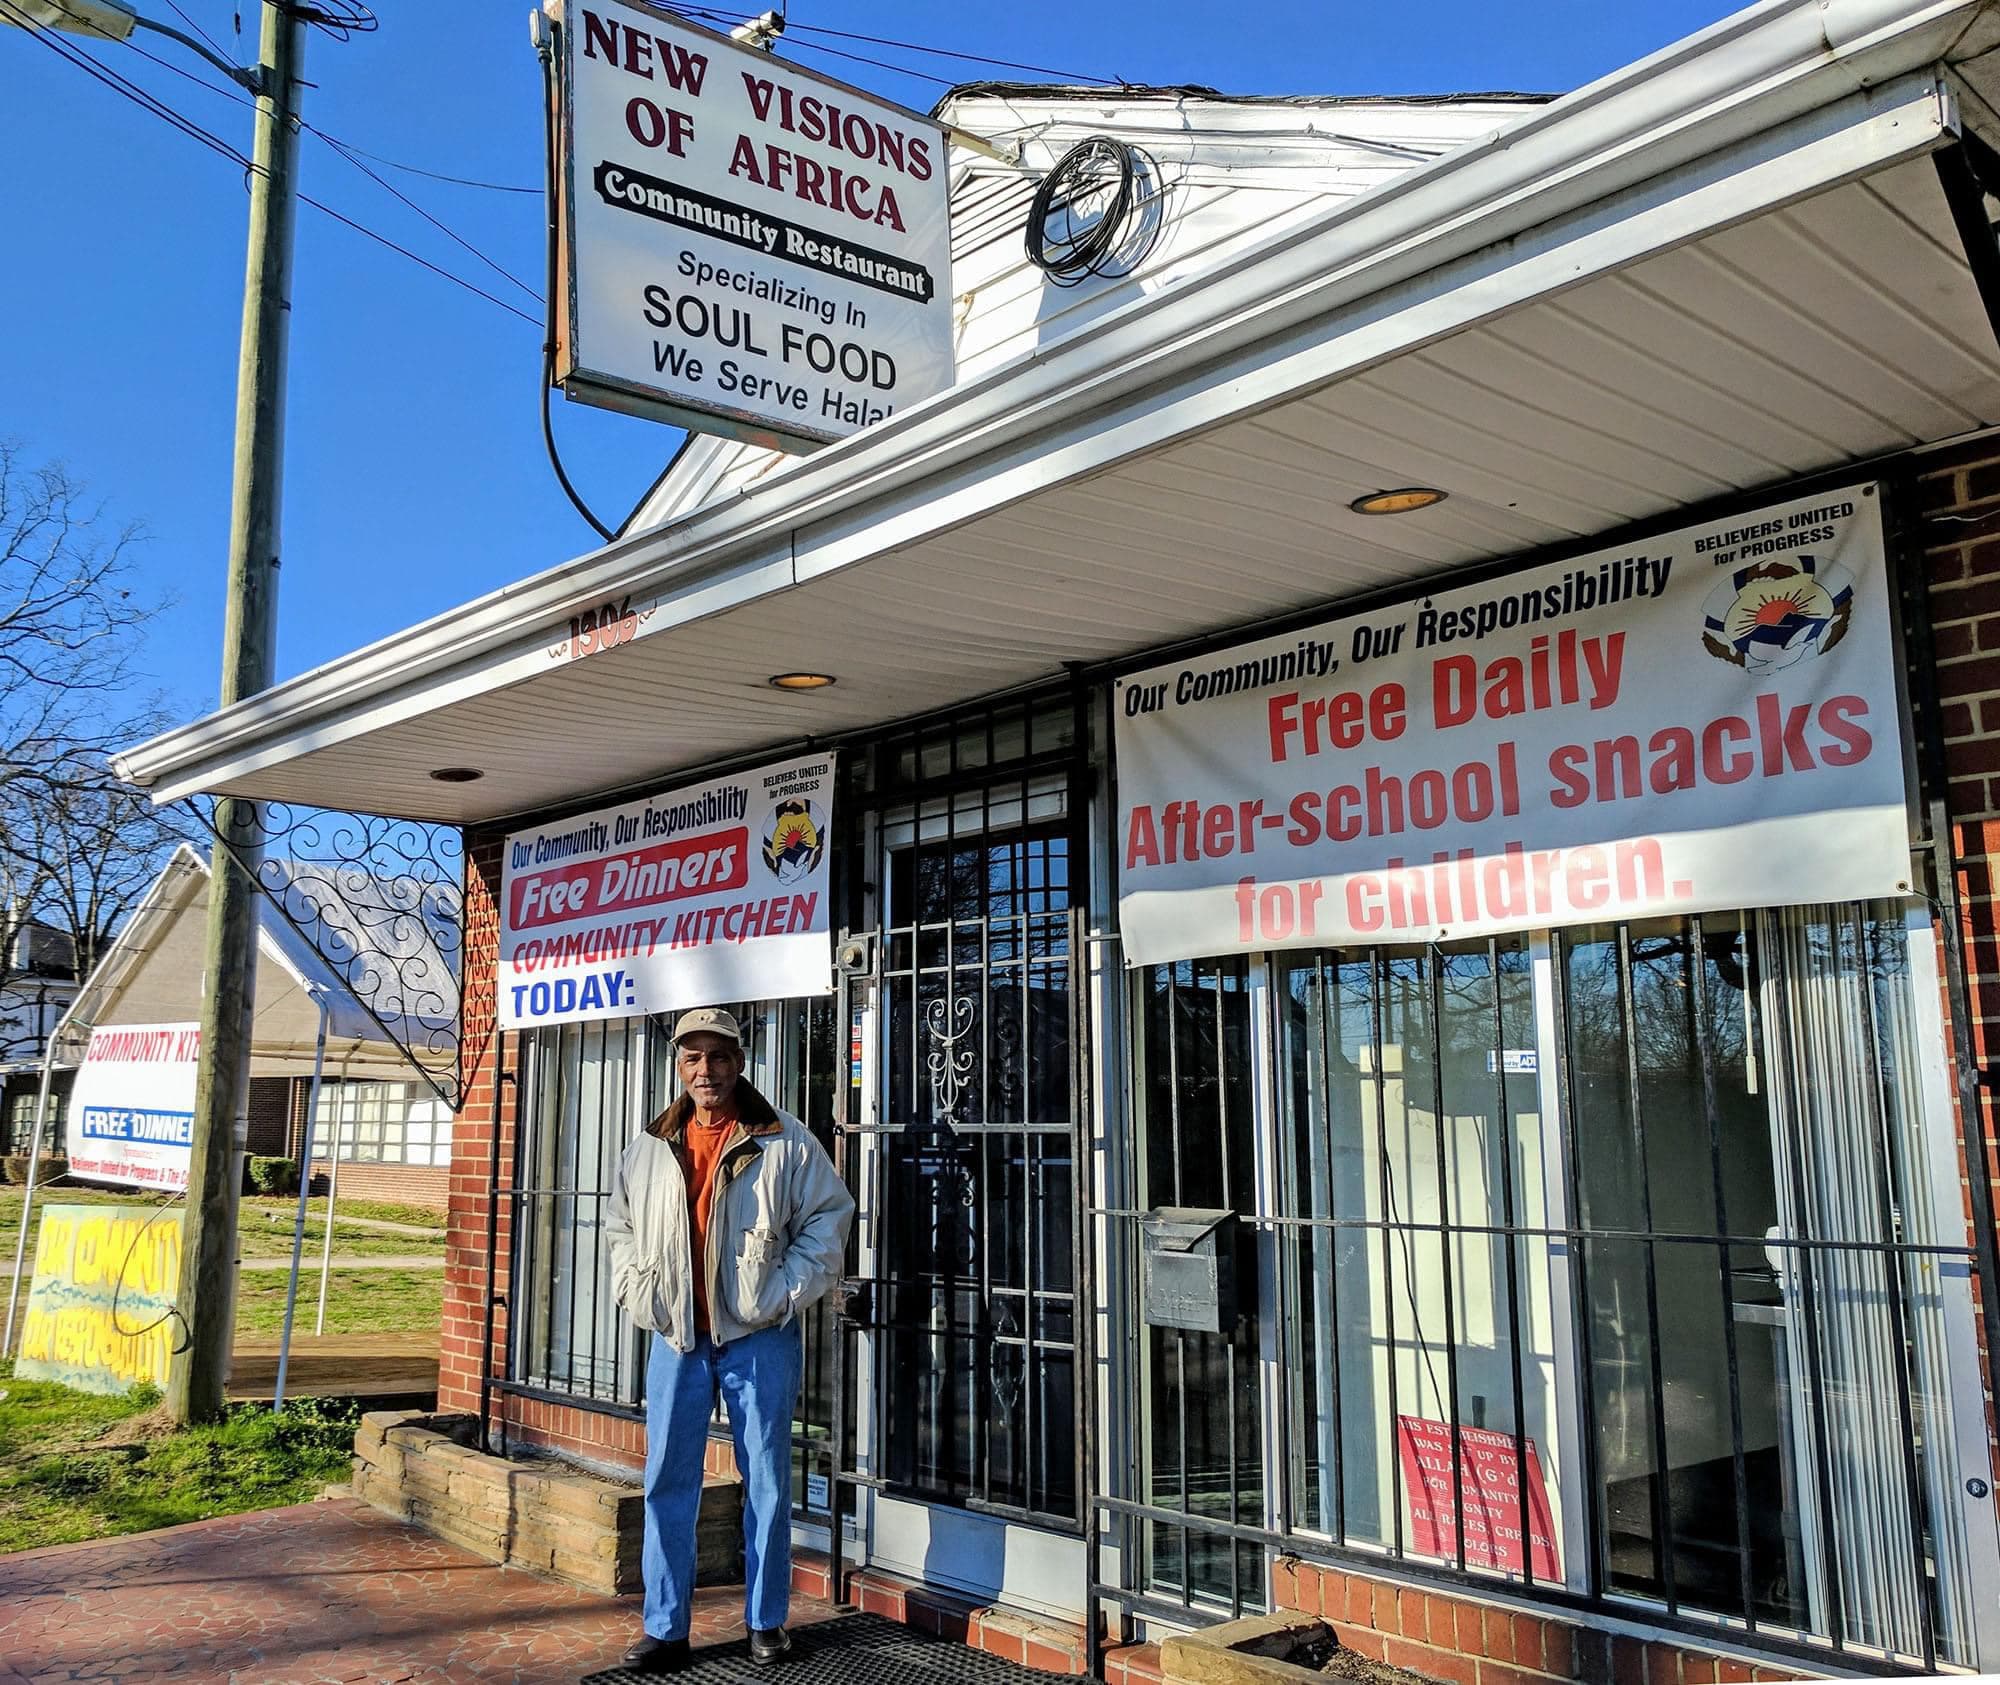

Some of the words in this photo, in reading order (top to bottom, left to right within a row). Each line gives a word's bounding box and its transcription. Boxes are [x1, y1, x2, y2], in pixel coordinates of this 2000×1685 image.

[582, 9, 708, 97] NEW
[741, 71, 933, 181] VISIONS
[625, 97, 695, 158] OF
[728, 134, 906, 233] AFRICA
[604, 169, 778, 252] Community
[785, 227, 926, 295] Restaurant
[678, 251, 836, 323] Specializing
[846, 301, 867, 329] In
[643, 284, 767, 357] SOUL
[782, 324, 896, 390] FOOD
[652, 340, 703, 381] We
[718, 360, 808, 410] Serve
[1695, 519, 1784, 553] BELIEVERS
[1788, 502, 1854, 529] UNITED
[1714, 551, 1737, 566] for
[1741, 525, 1835, 559] PROGRESS
[568, 595, 638, 659] 1906
[1124, 680, 1168, 718] Our
[1175, 638, 1340, 704] Community,
[1351, 619, 1406, 664] Our
[1416, 556, 1673, 648] Responsibility
[1268, 681, 1407, 763] Free
[1432, 629, 1627, 725] Daily
[763, 770, 797, 787] BELIEVERS
[799, 764, 829, 779] UNITED
[770, 789, 778, 799] for
[779, 779, 820, 796] PROGRESS
[1125, 742, 1520, 869] After-school
[1548, 691, 1874, 808] snacks
[511, 840, 534, 870] Our
[535, 822, 609, 864] Community,
[614, 814, 640, 841] Our
[642, 786, 749, 839] Responsibility
[519, 876, 591, 928] Free
[598, 843, 737, 906] Dinners
[1234, 875, 1324, 941] for
[1347, 838, 1693, 933] children.
[512, 916, 669, 974] COMMUNITY
[671, 891, 819, 950] KITCHEN
[511, 970, 635, 1018] TODAY:
[88, 1032, 173, 1062] COMMUNITY
[175, 1031, 200, 1062] KIT
[86, 1110, 129, 1137] FREE
[1413, 1437, 1443, 1452] WAS
[1477, 1449, 1494, 1462] UP
[1499, 1453, 1517, 1467] BY
[1462, 1484, 1520, 1505] UMANITY
[1463, 1538, 1508, 1557] OLORS
